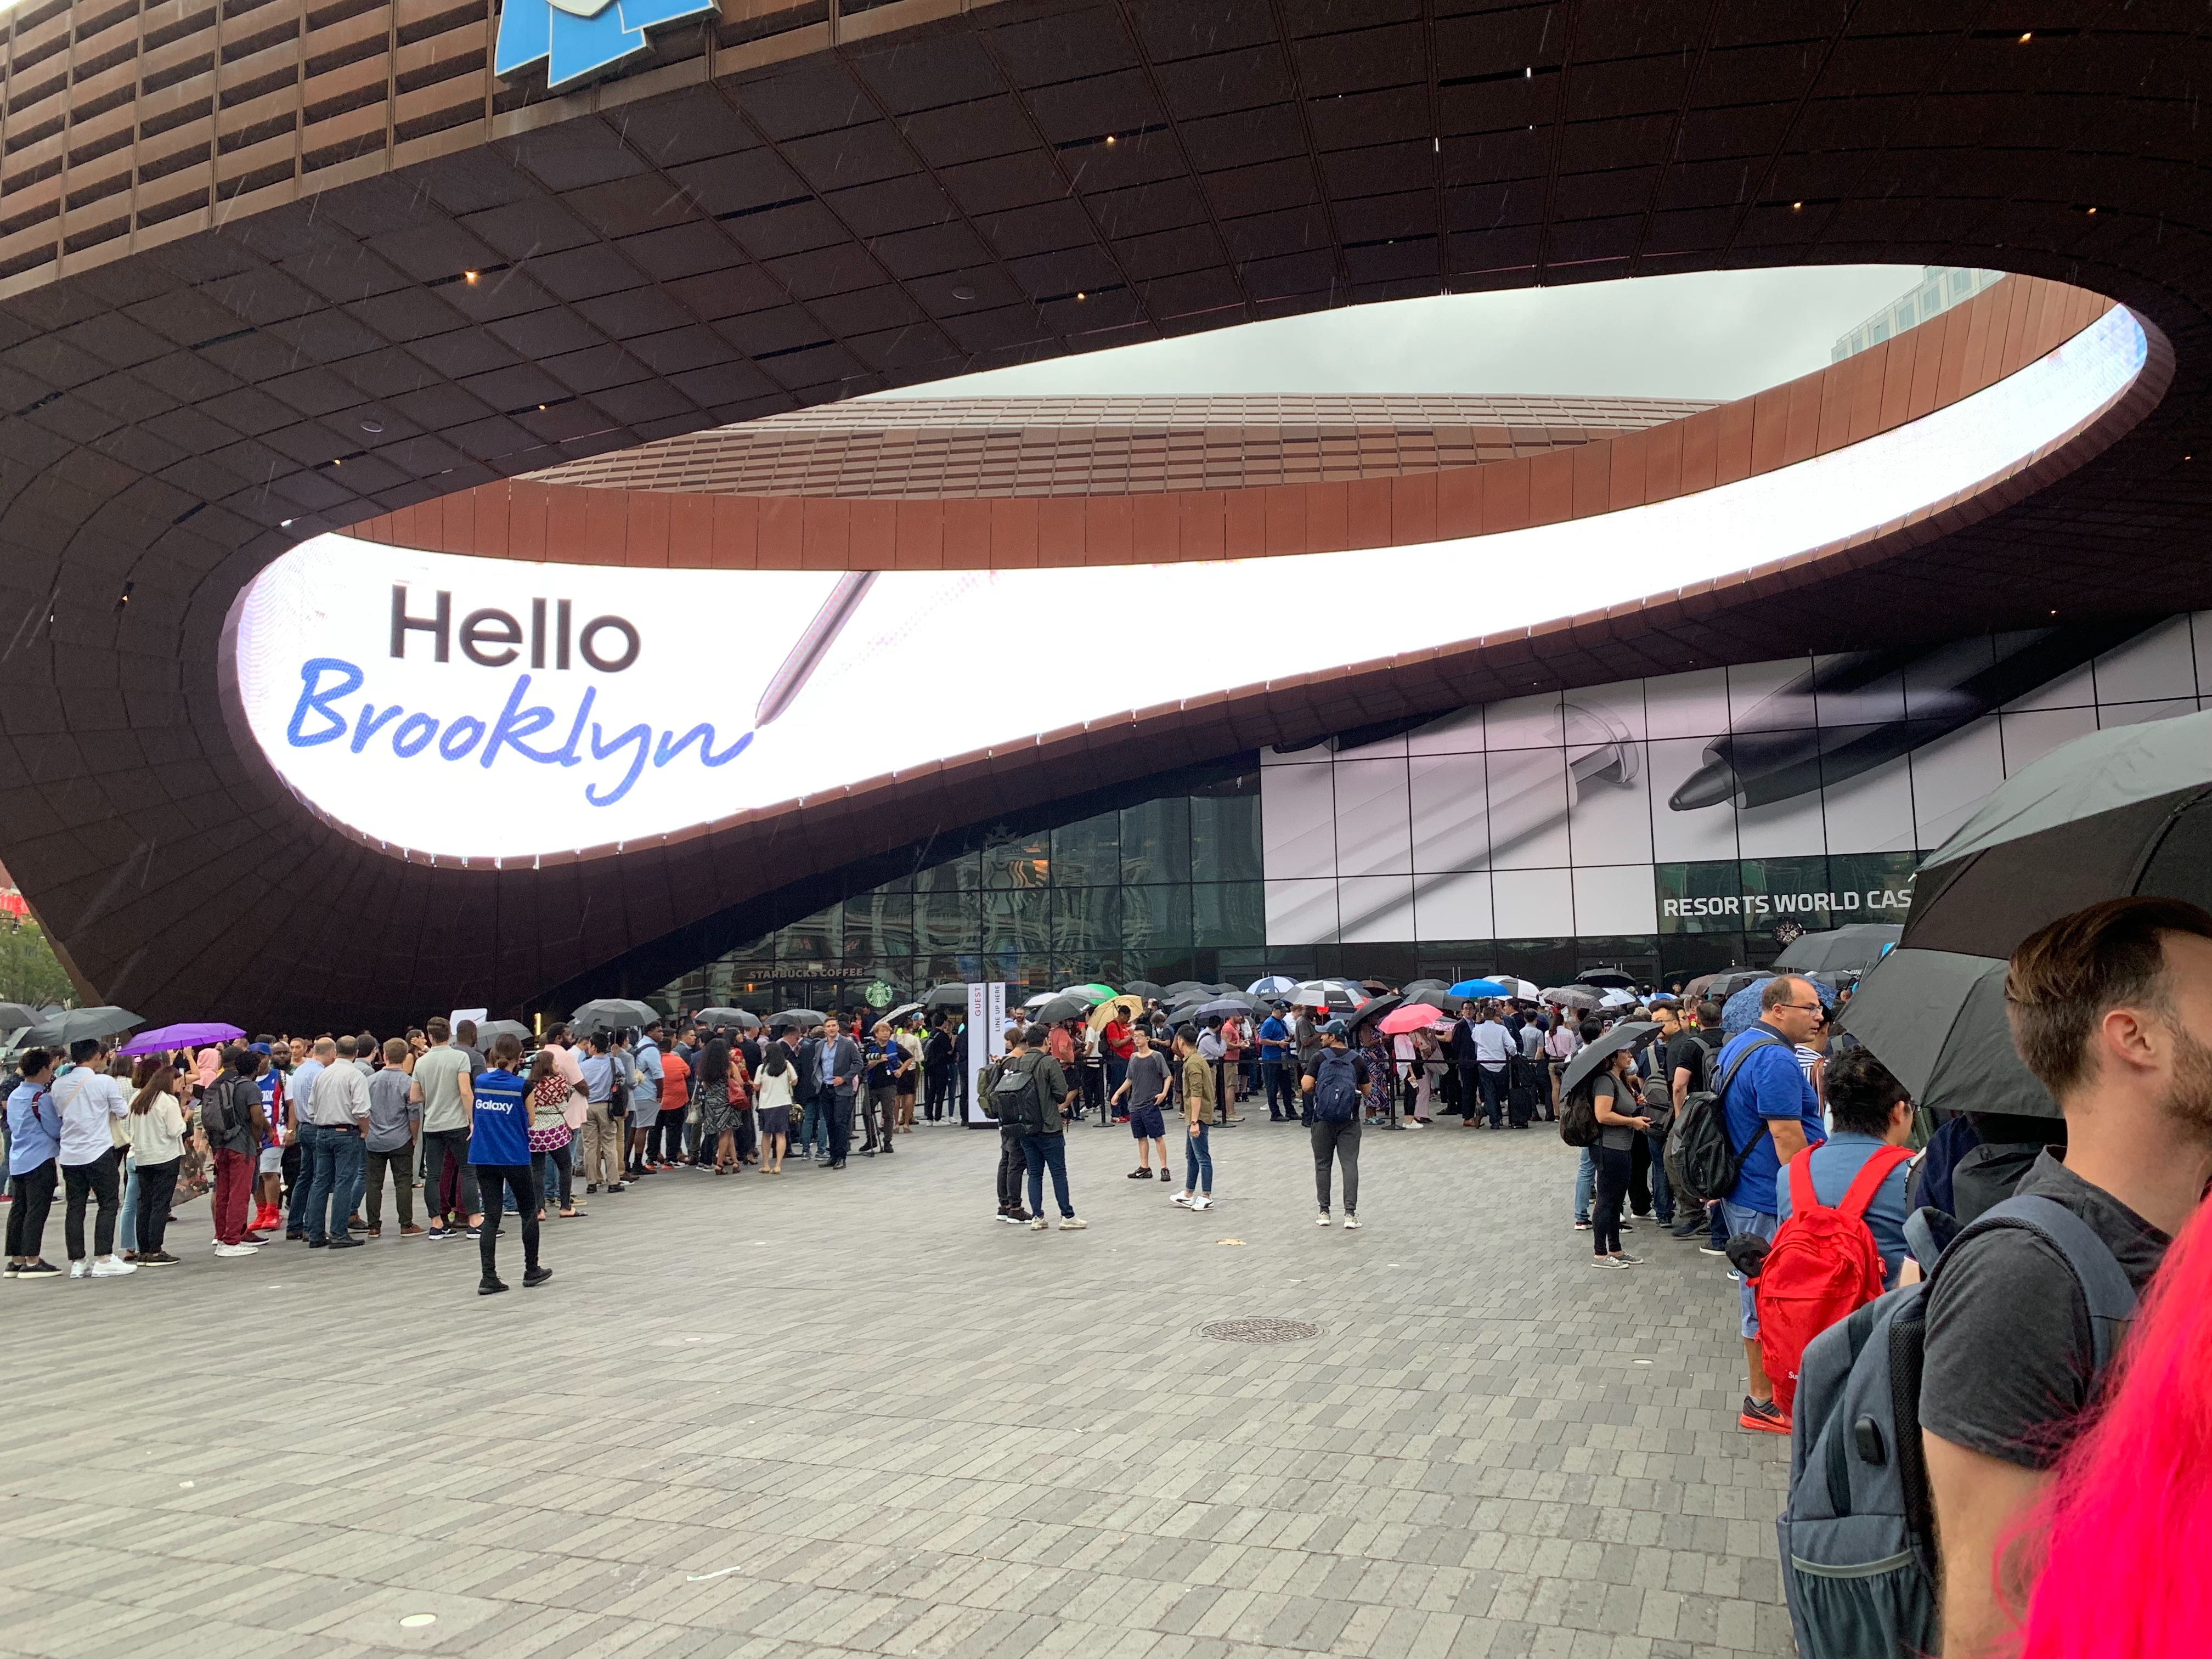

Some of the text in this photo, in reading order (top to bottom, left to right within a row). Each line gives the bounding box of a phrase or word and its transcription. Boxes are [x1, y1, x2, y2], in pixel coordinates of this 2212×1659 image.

[390, 584, 641, 673] Hello
[287, 657, 754, 807] Brooklyn
[1663, 889, 1915, 917] RESORTS WORLD CAS
[749, 968, 864, 979] STARBUCKS COFFEE
[995, 1005, 1000, 1014] UP
[475, 1099, 514, 1115] Galaxy
